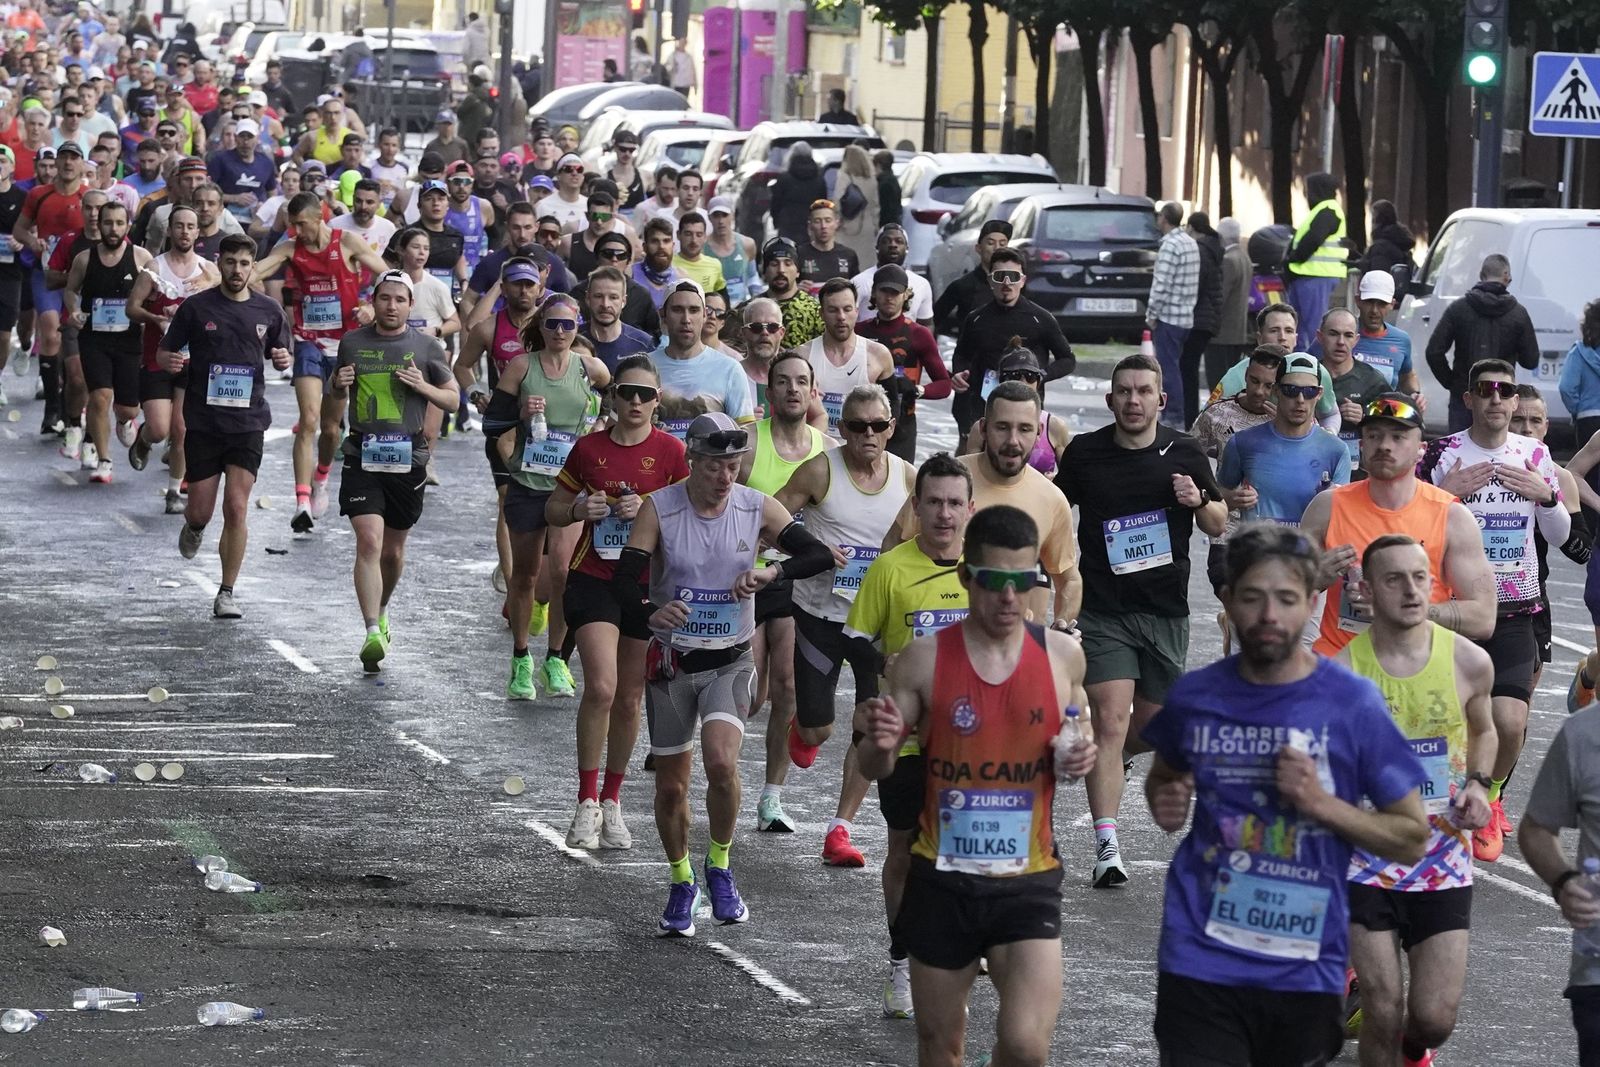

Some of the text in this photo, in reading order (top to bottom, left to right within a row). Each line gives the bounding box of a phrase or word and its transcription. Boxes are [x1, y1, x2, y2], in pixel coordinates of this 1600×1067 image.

[307, 313, 336, 321] RUBENS
[225, 367, 250, 375] ZURICH
[217, 387, 244, 397] DAVID
[372, 453, 402, 463] EL JEJ
[532, 452, 566, 466] NICOLE
[1486, 492, 1497, 503] &
[1125, 514, 1160, 528] ZURICH
[1490, 520, 1522, 528] ZURICH
[604, 534, 629, 546] COL
[1128, 533, 1148, 544] 6308
[1490, 536, 1509, 544] 5504
[1124, 543, 1155, 559] MATT
[1500, 547, 1525, 558] COBO
[940, 592, 960, 600] vive
[697, 610, 718, 619] 7150
[929, 758, 972, 784] CDA
[971, 821, 1000, 832] 6139
[953, 837, 1017, 855] TULKAS
[1257, 860, 1319, 881] ZURICH
[1217, 900, 1240, 922] EL
[1247, 907, 1317, 935] GUAPO
